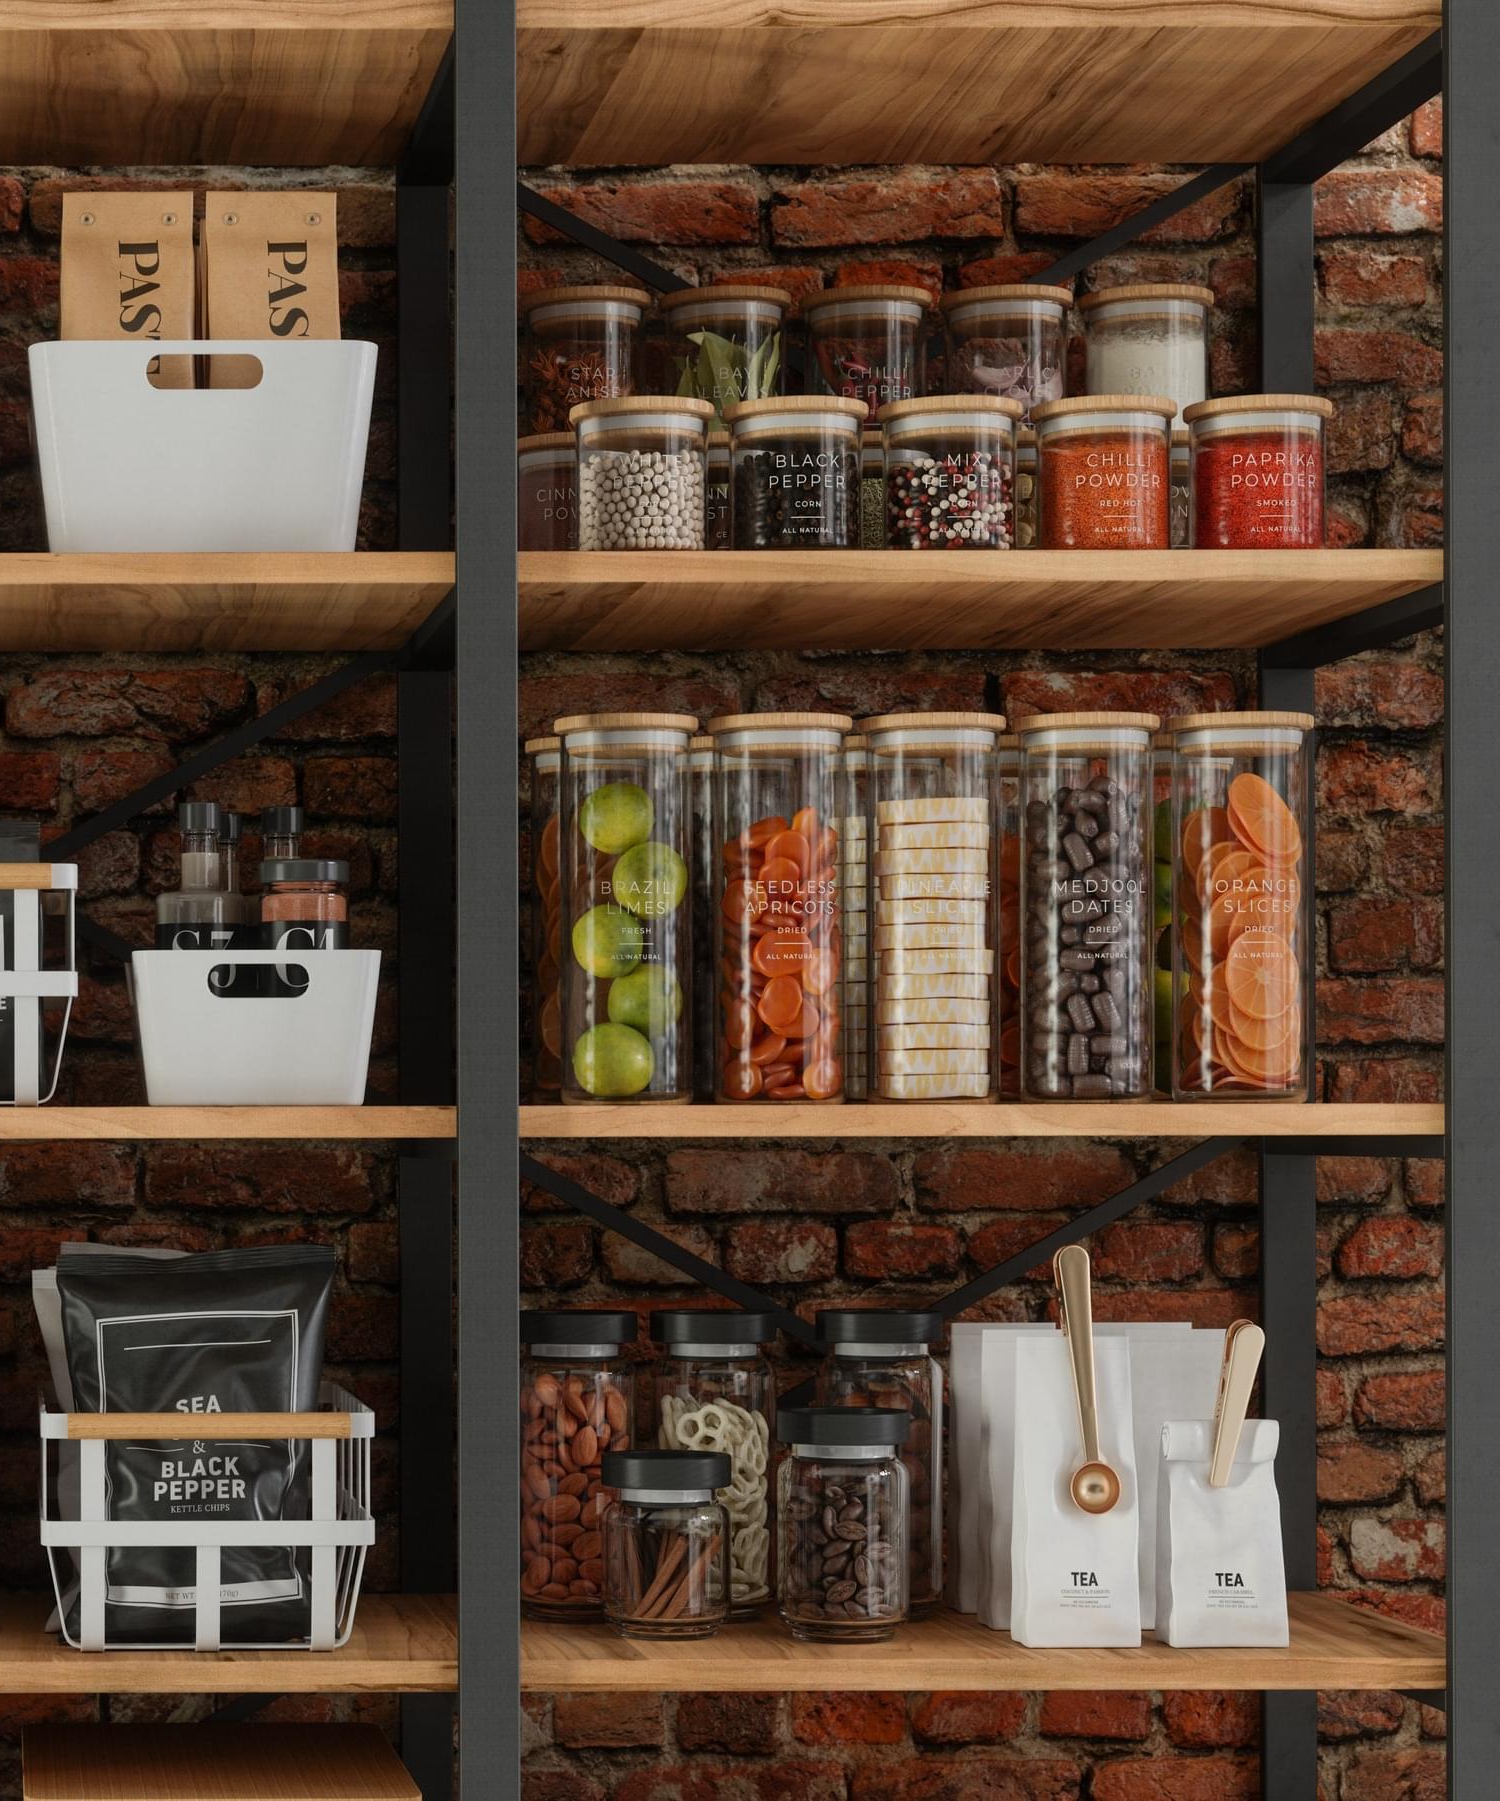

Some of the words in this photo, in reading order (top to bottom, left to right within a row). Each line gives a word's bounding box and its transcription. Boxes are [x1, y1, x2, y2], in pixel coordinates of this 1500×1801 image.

[571, 367, 617, 381] STAR
[847, 366, 908, 380] CHILLI
[565, 386, 620, 400] ANISE
[841, 385, 911, 399] PEPPER
[775, 453, 840, 468] BLACK
[947, 452, 983, 467] MIX
[1086, 452, 1151, 467] CHILLI
[1232, 452, 1316, 468] PAPRIKA
[768, 473, 846, 489] PEPPER
[1074, 472, 1161, 489] POWDER
[1231, 472, 1317, 489] POWDER
[794, 500, 823, 508] CORN
[1099, 499, 1120, 507] RED
[1123, 499, 1142, 507] HOT
[1256, 499, 1297, 507] SMOKED
[798, 526, 834, 534] NATURAL
[601, 880, 671, 895] BRAZIL
[744, 880, 835, 894] SEEDLESS
[1052, 879, 1146, 894] MEDJOOL
[1215, 879, 1297, 894] ORANGE
[606, 900, 667, 915] LIMES
[746, 900, 836, 914] APRICOTS
[1071, 899, 1133, 914] DATES
[1223, 899, 1294, 913] SLICES
[621, 927, 652, 935] FRESH
[777, 926, 808, 934] DRIED
[1089, 926, 1119, 934] DRIED
[1244, 925, 1275, 933] DRIED
[627, 953, 661, 961] NATURAL
[1077, 952, 1093, 960] ALL
[1095, 952, 1130, 960] NATURAL
[175, 1394, 222, 1414] SEA
[192, 1439, 208, 1454] &
[161, 1456, 241, 1479] BLACK
[154, 1479, 246, 1502] PEPPER
[170, 1504, 204, 1514] KETTLE
[204, 1503, 231, 1513] CHIPS
[1071, 1572, 1099, 1587] TEA
[1215, 1573, 1245, 1587] TEA
